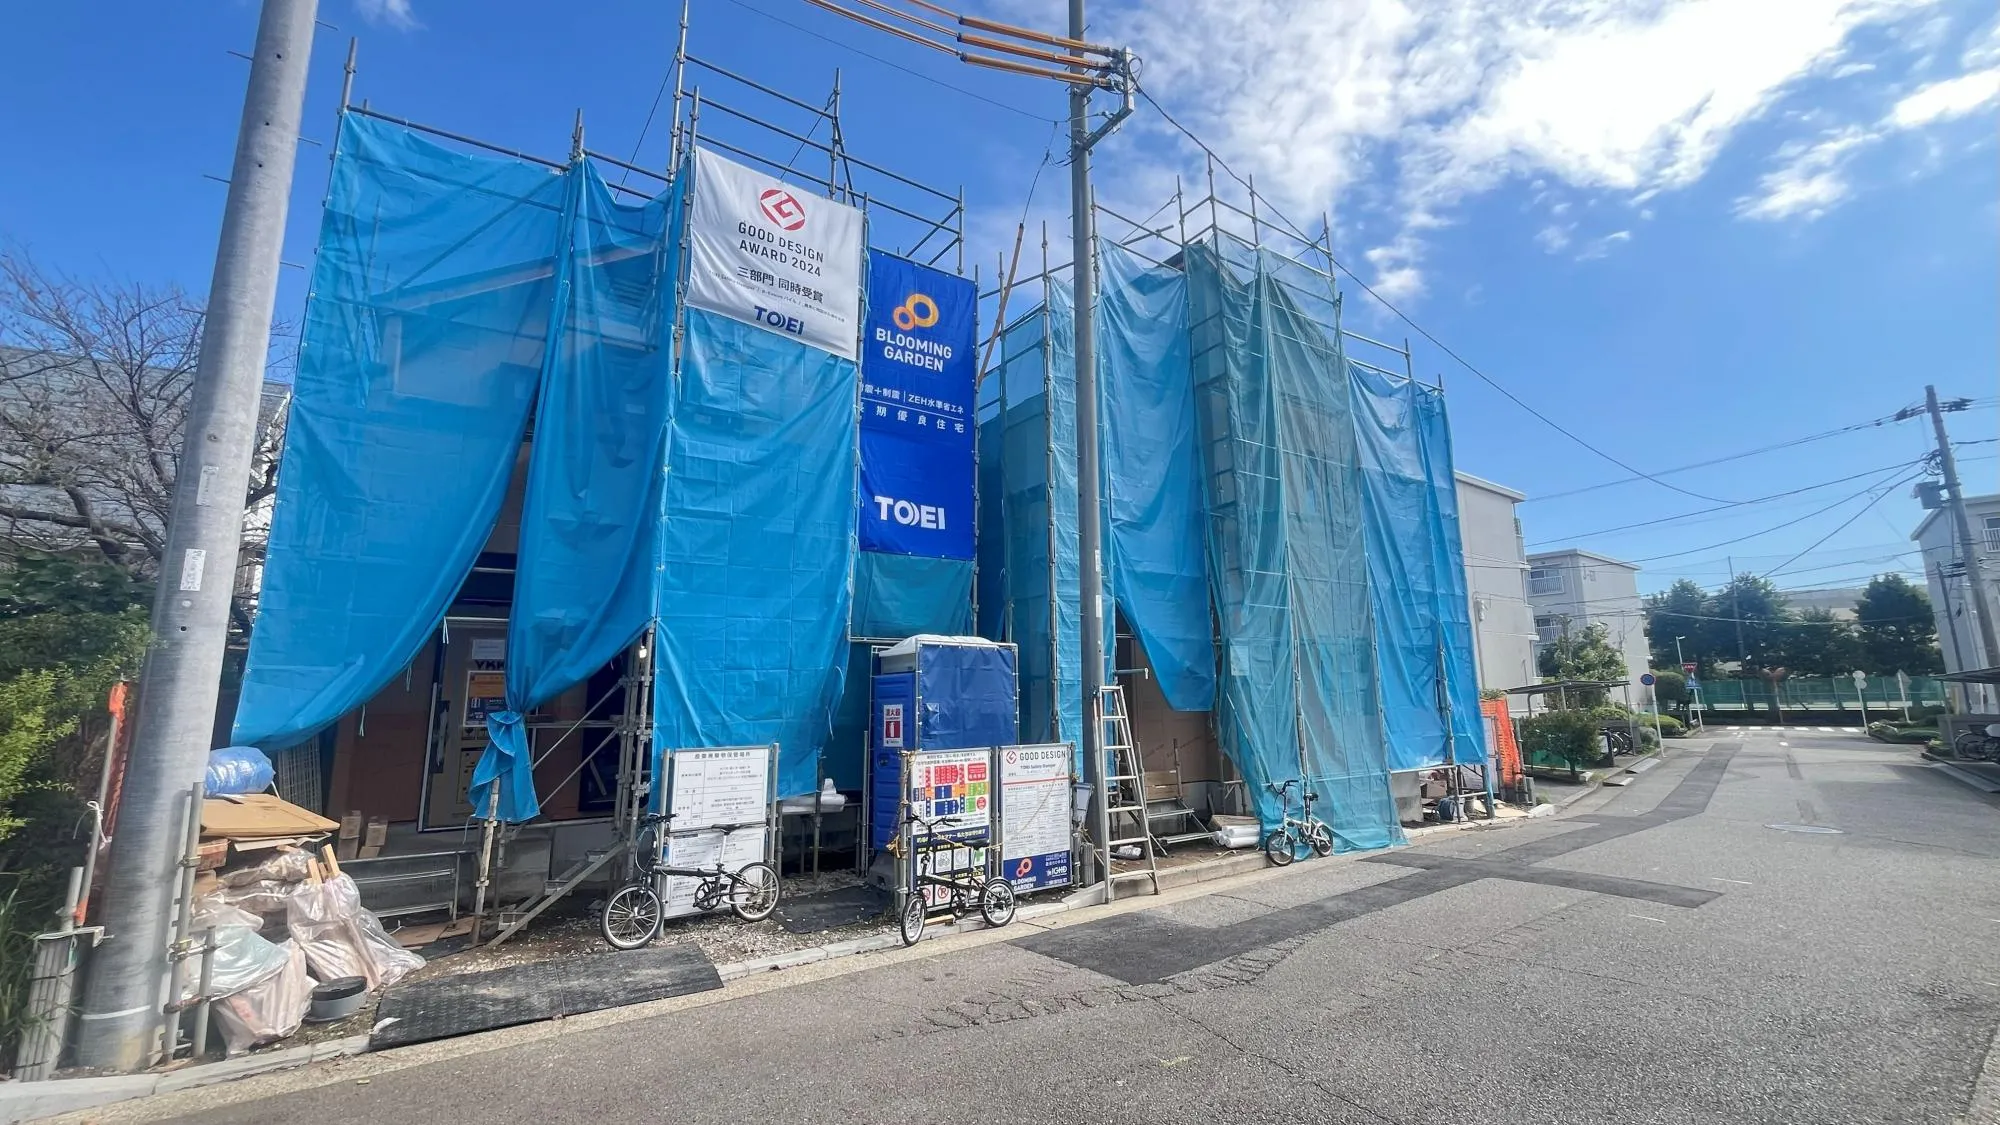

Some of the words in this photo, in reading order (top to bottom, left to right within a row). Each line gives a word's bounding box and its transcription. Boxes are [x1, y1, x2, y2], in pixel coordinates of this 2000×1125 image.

[738, 221, 775, 243] GOOD
[778, 237, 825, 264] DESIGN
[739, 239, 787, 265] AWARD
[791, 257, 822, 278] 2024
[737, 266, 774, 287] 三部門
[778, 277, 824, 304] 同時受賞
[876, 327, 952, 360] BLOOMING
[884, 344, 944, 373] GARDEN
[1020, 752, 1039, 761] GOOD
[1041, 750, 1066, 759] DESIGN
[1011, 876, 1036, 886] BLOOMING
[1013, 883, 1034, 891] GARDEN
